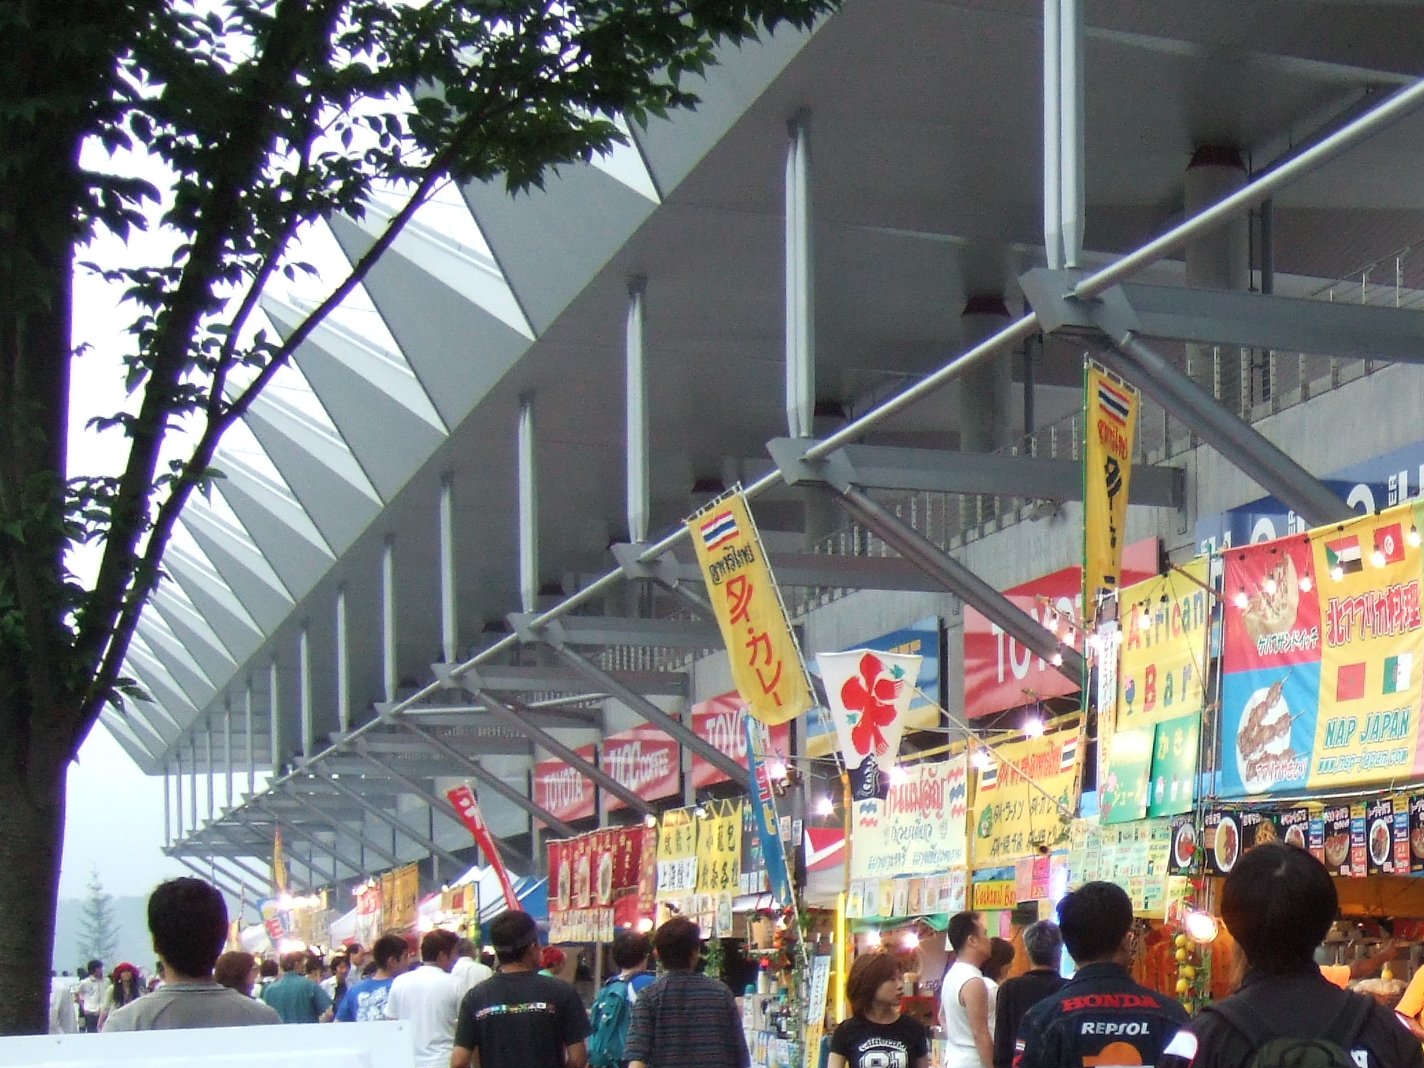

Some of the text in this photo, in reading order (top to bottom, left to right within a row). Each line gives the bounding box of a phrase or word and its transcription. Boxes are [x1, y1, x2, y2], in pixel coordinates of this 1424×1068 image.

[1143, 662, 1192, 713] Bar
[1323, 706, 1412, 750] NAP JAPAN
[1062, 995, 1162, 1012] HONDA
[1081, 1022, 1150, 1036] REPSOL
